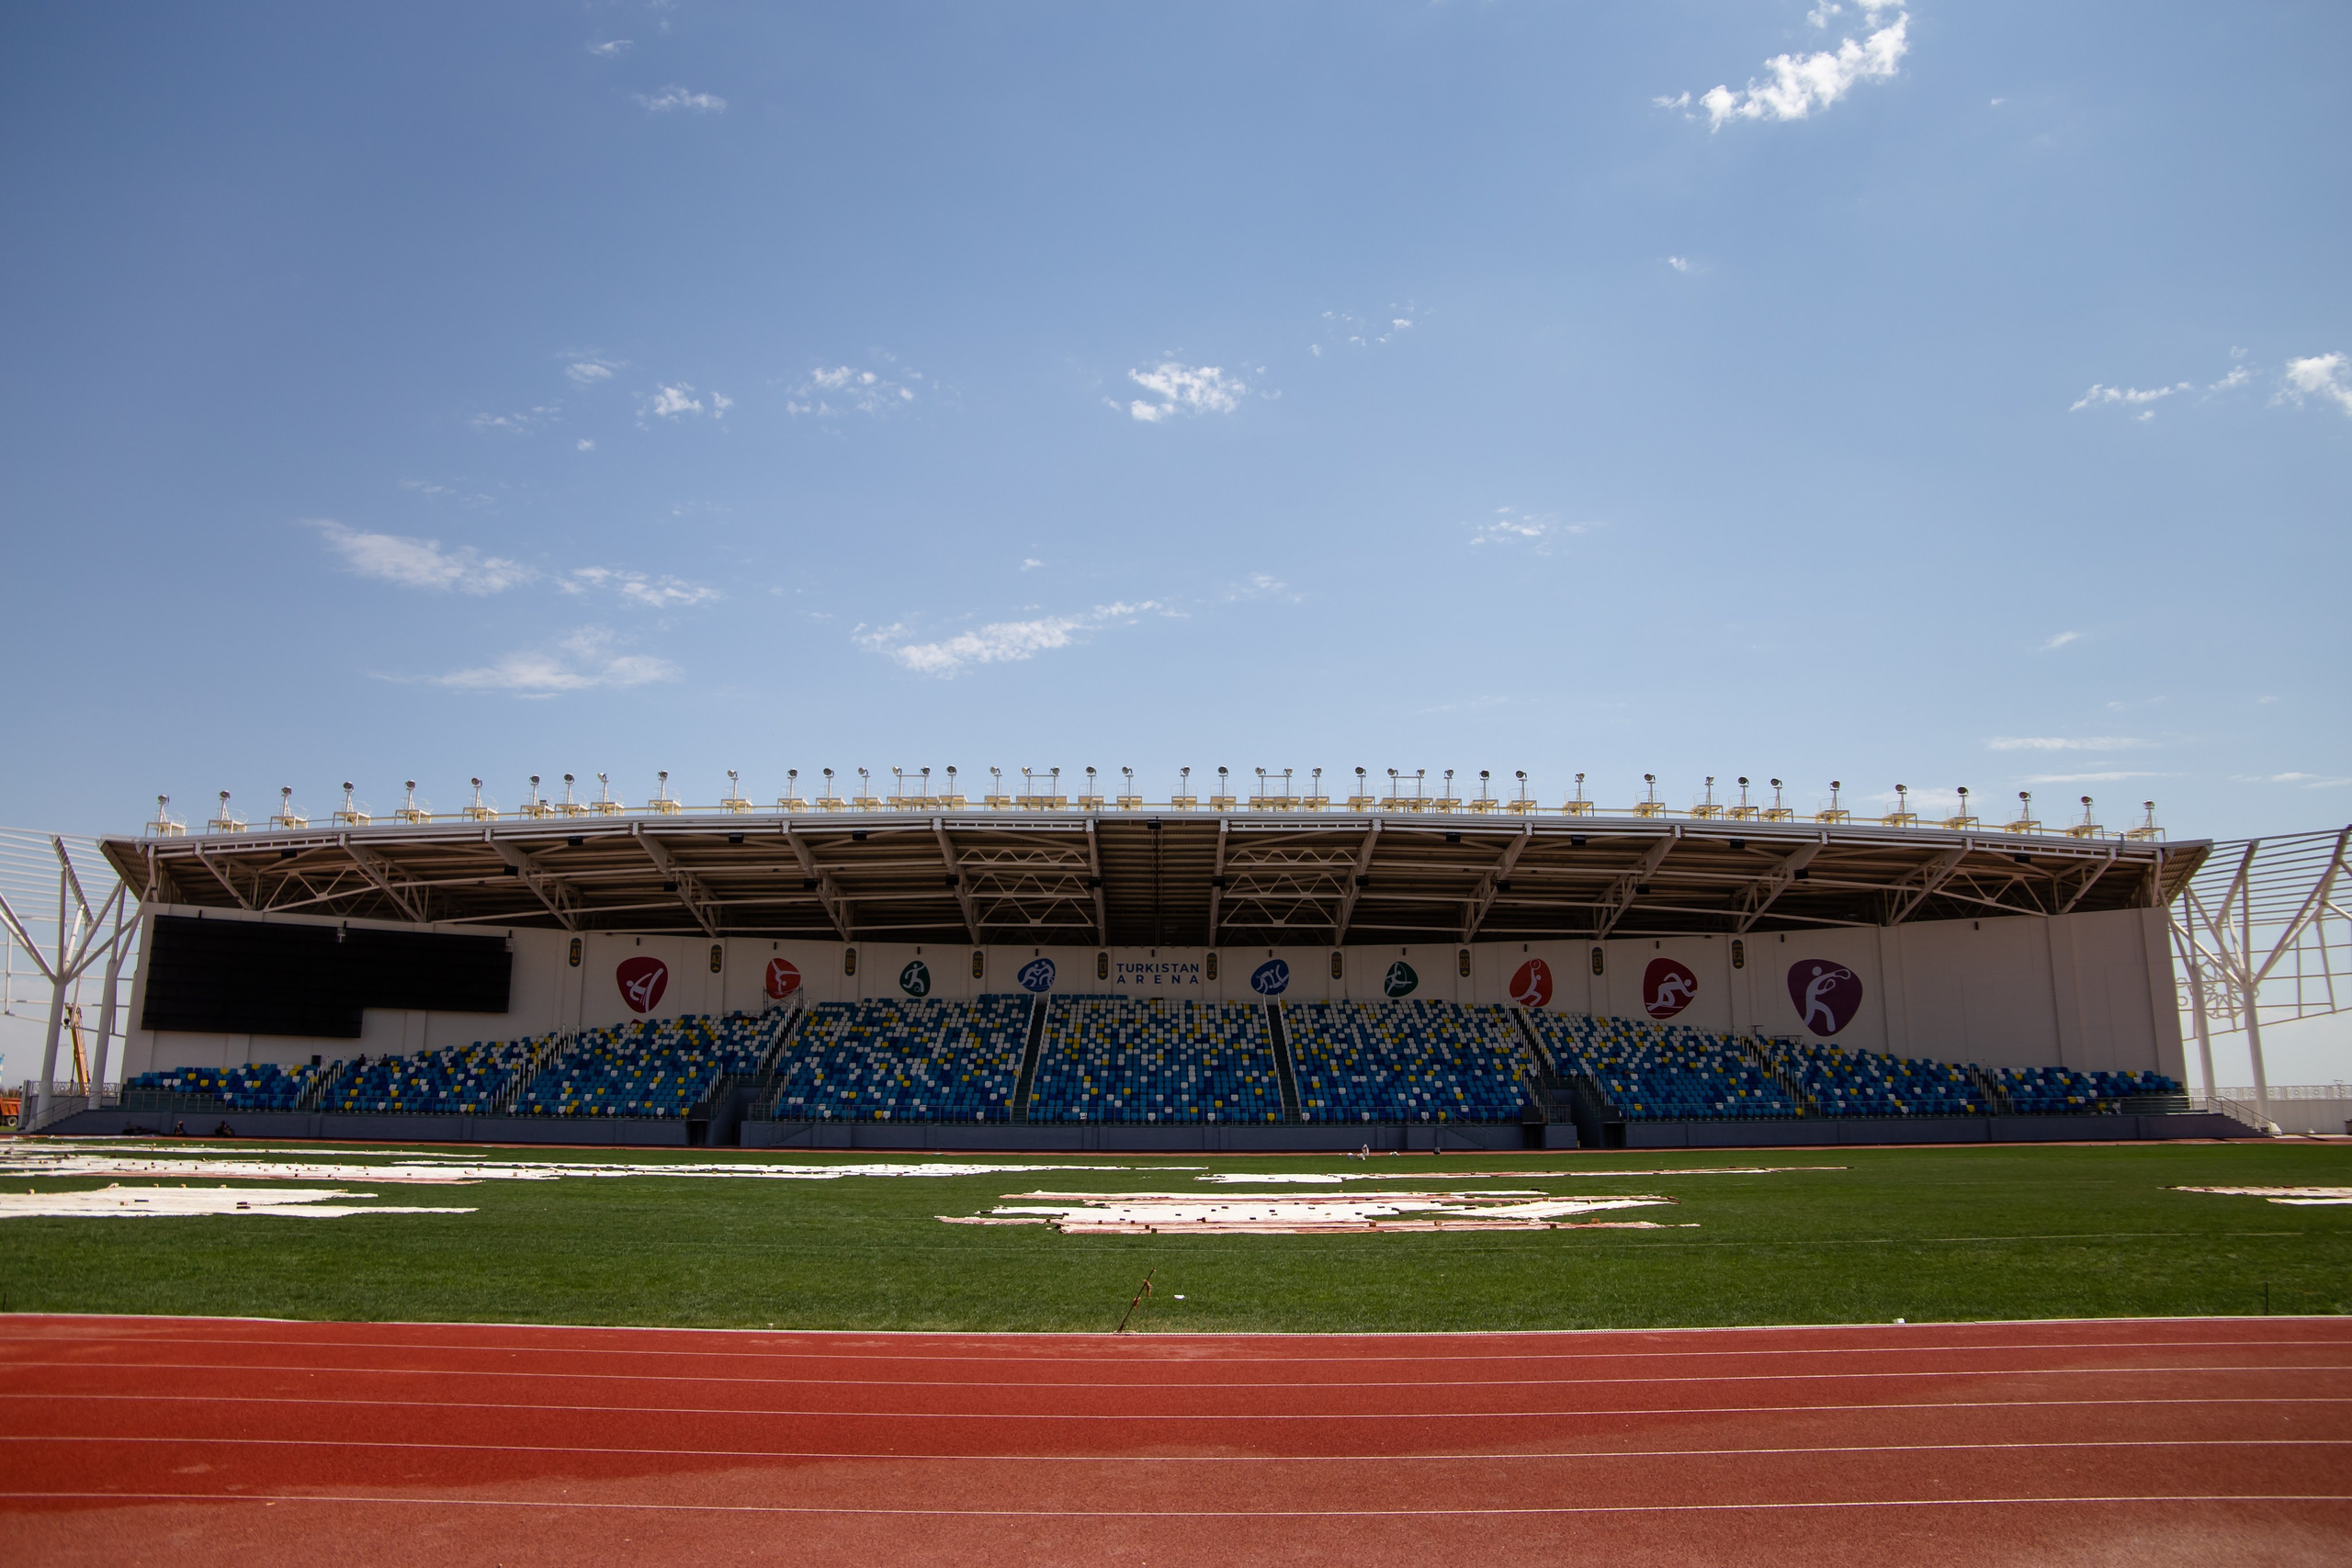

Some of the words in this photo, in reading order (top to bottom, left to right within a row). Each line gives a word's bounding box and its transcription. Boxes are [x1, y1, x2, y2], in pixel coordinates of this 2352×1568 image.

[571, 947, 580, 958] A1
[711, 954, 720, 964] A2
[846, 957, 854, 966] B1
[974, 961, 982, 969] B2
[1116, 963, 1199, 973] TURKISTAN
[1116, 975, 1199, 984] ARENA
